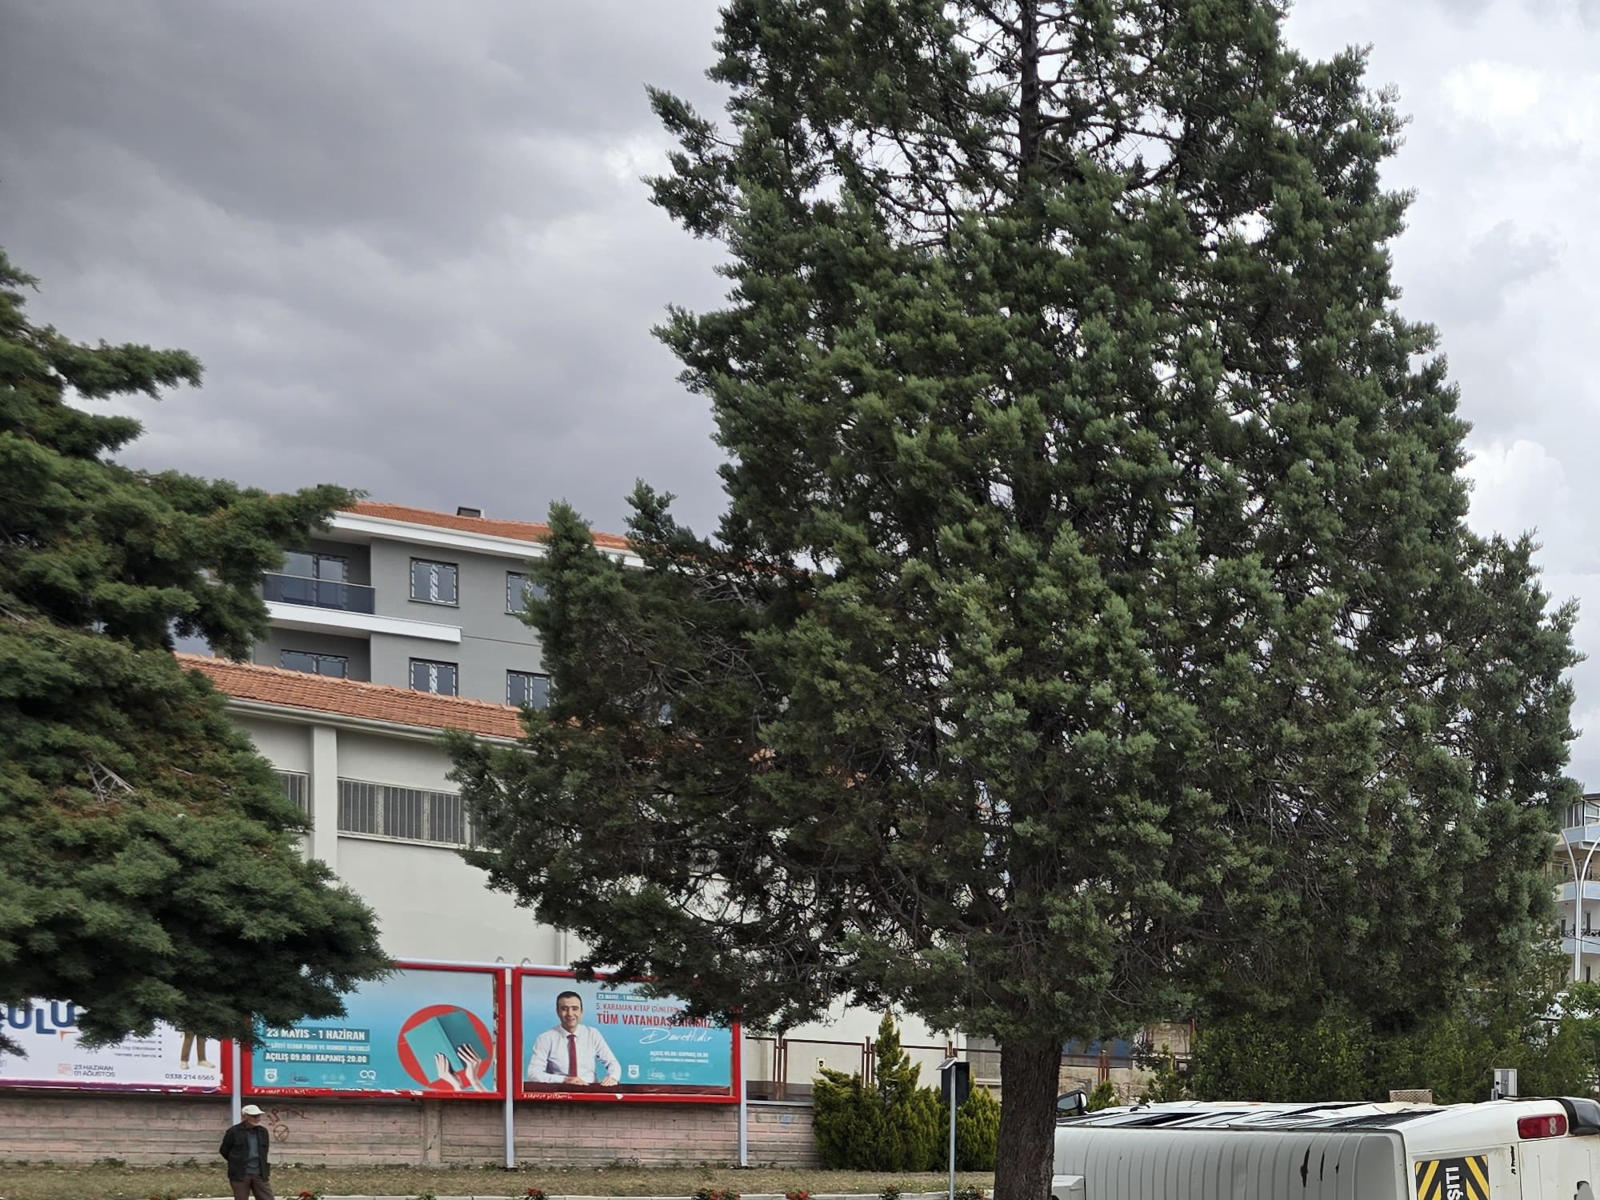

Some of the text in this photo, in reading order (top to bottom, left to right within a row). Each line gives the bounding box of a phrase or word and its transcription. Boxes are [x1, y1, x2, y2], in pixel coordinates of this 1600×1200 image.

[597, 1011, 619, 1025] TÜM
[281, 1028, 310, 1039] MAYIS
[326, 1029, 365, 1041] HAZİRAN
